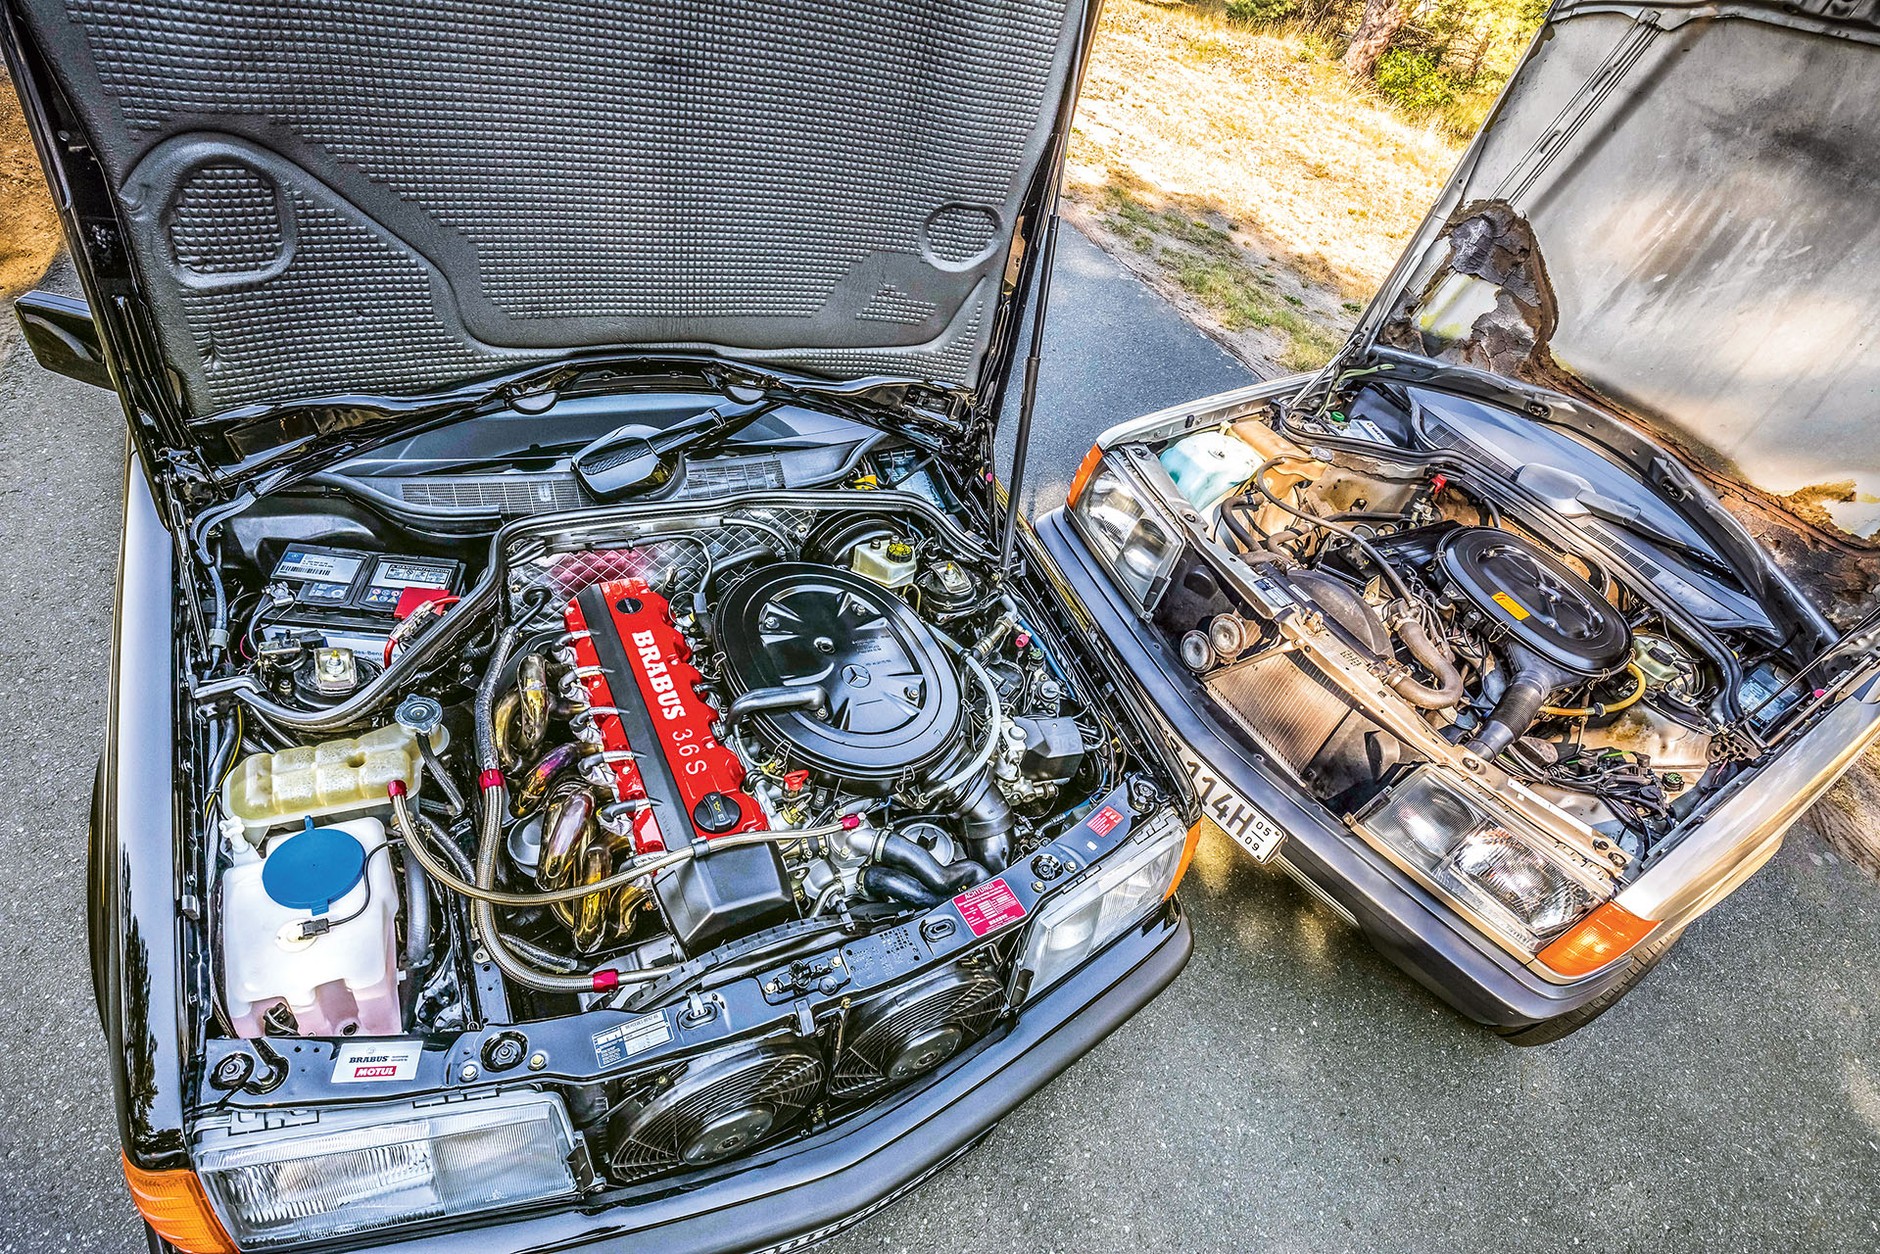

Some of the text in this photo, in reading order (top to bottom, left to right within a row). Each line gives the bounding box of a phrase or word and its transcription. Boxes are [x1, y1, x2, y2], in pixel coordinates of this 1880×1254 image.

[632, 629, 686, 720] BRABUS
[672, 728, 707, 775] 3.6 S
[1255, 821, 1272, 837] 05
[1244, 836, 1260, 852] 09
[964, 882, 995, 900] ACHTUNG!
[349, 1055, 389, 1063] BRABUS
[356, 1067, 394, 1077] MOTUL
